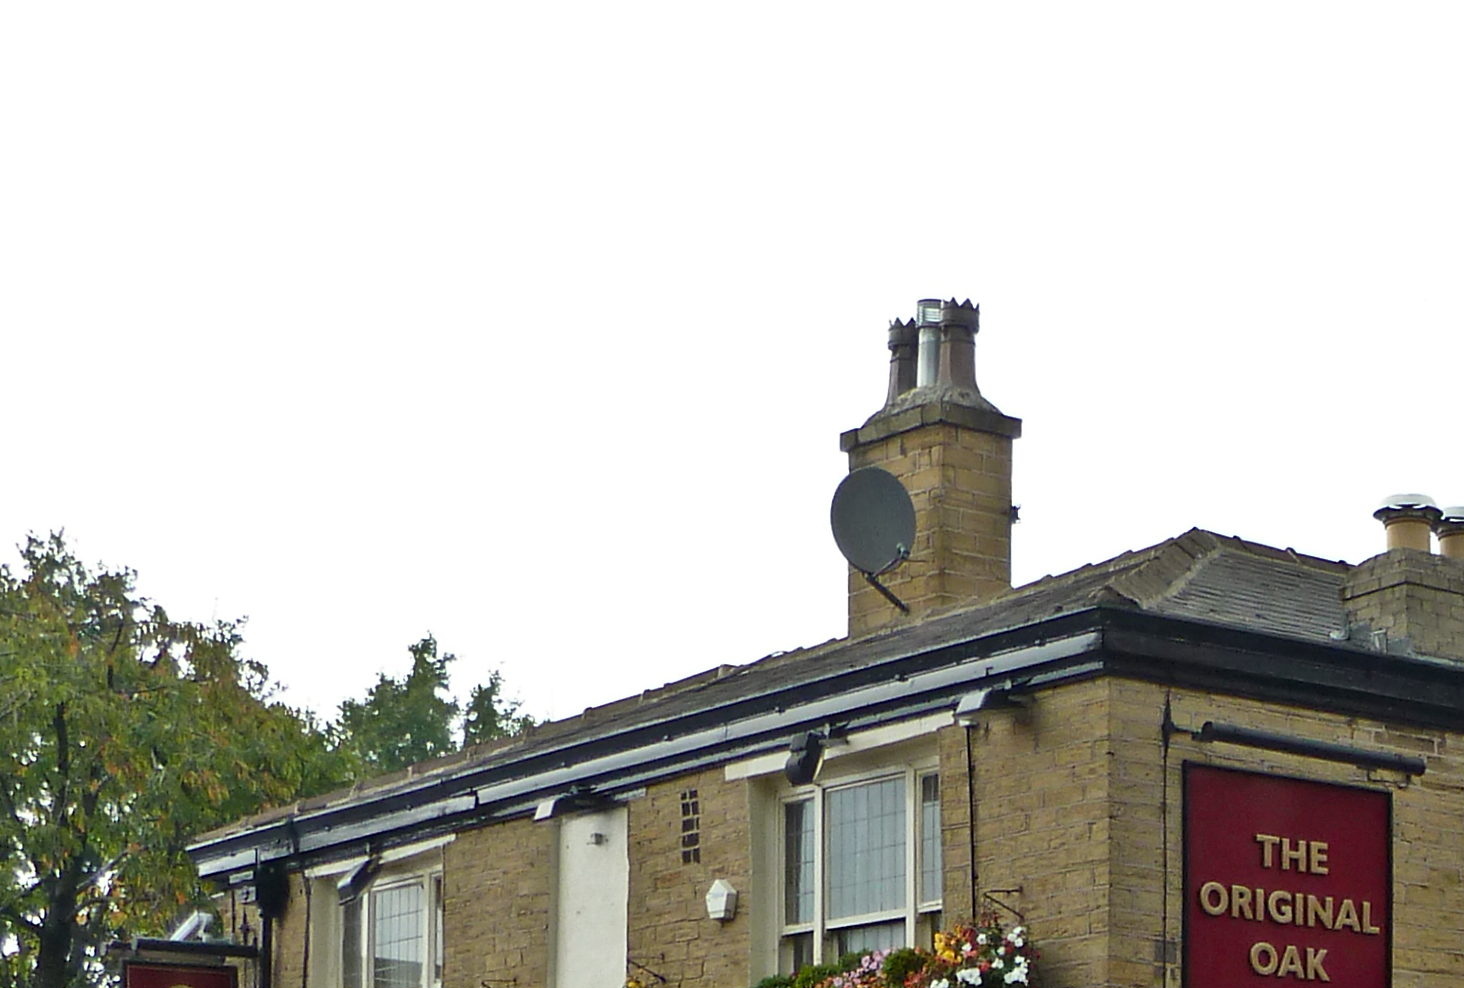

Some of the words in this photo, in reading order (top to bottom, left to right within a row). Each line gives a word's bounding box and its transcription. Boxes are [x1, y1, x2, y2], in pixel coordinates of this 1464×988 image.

[1255, 833, 1329, 875] THE
[1200, 881, 1380, 934] ORIGINAL
[1250, 941, 1330, 982] OAK
